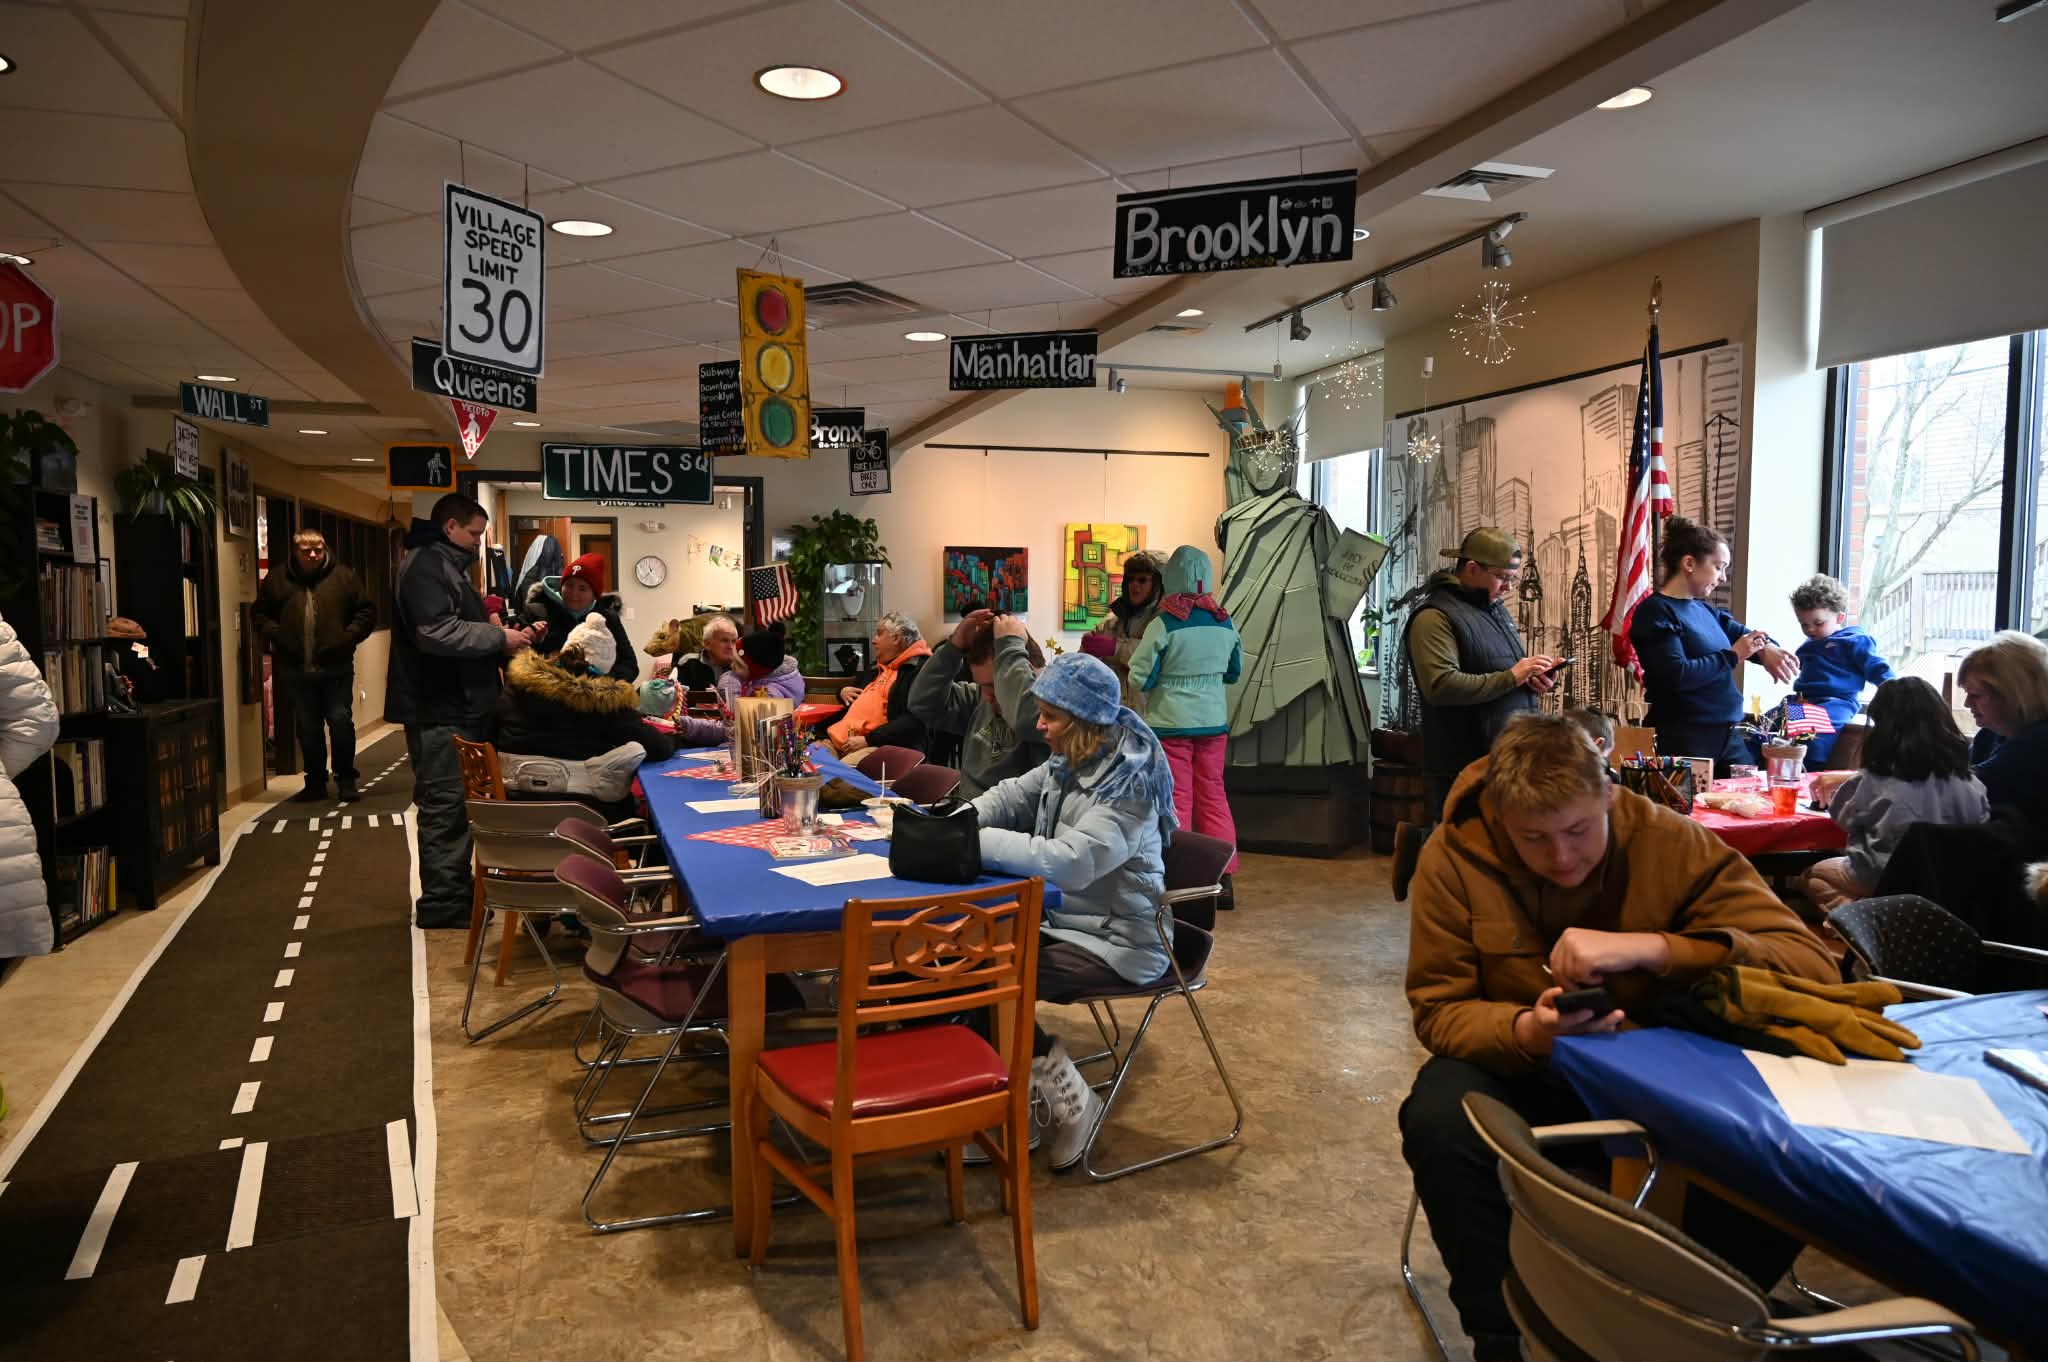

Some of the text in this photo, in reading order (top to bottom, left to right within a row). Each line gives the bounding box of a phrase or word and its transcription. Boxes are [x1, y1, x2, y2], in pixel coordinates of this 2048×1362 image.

[455, 202, 536, 248] VILLAGE
[1126, 195, 1342, 266] Brooklyn
[464, 230, 523, 262] SPEED
[468, 254, 518, 284] LIMIT
[458, 278, 532, 353] 30
[700, 366, 735, 379] Subway
[953, 339, 1096, 380] Manhattan
[433, 356, 526, 408] Queens
[701, 380, 738, 392] Downtown
[192, 386, 262, 422] WALL ST
[810, 414, 863, 442] Bronx
[552, 449, 709, 495] TIMES SQ
